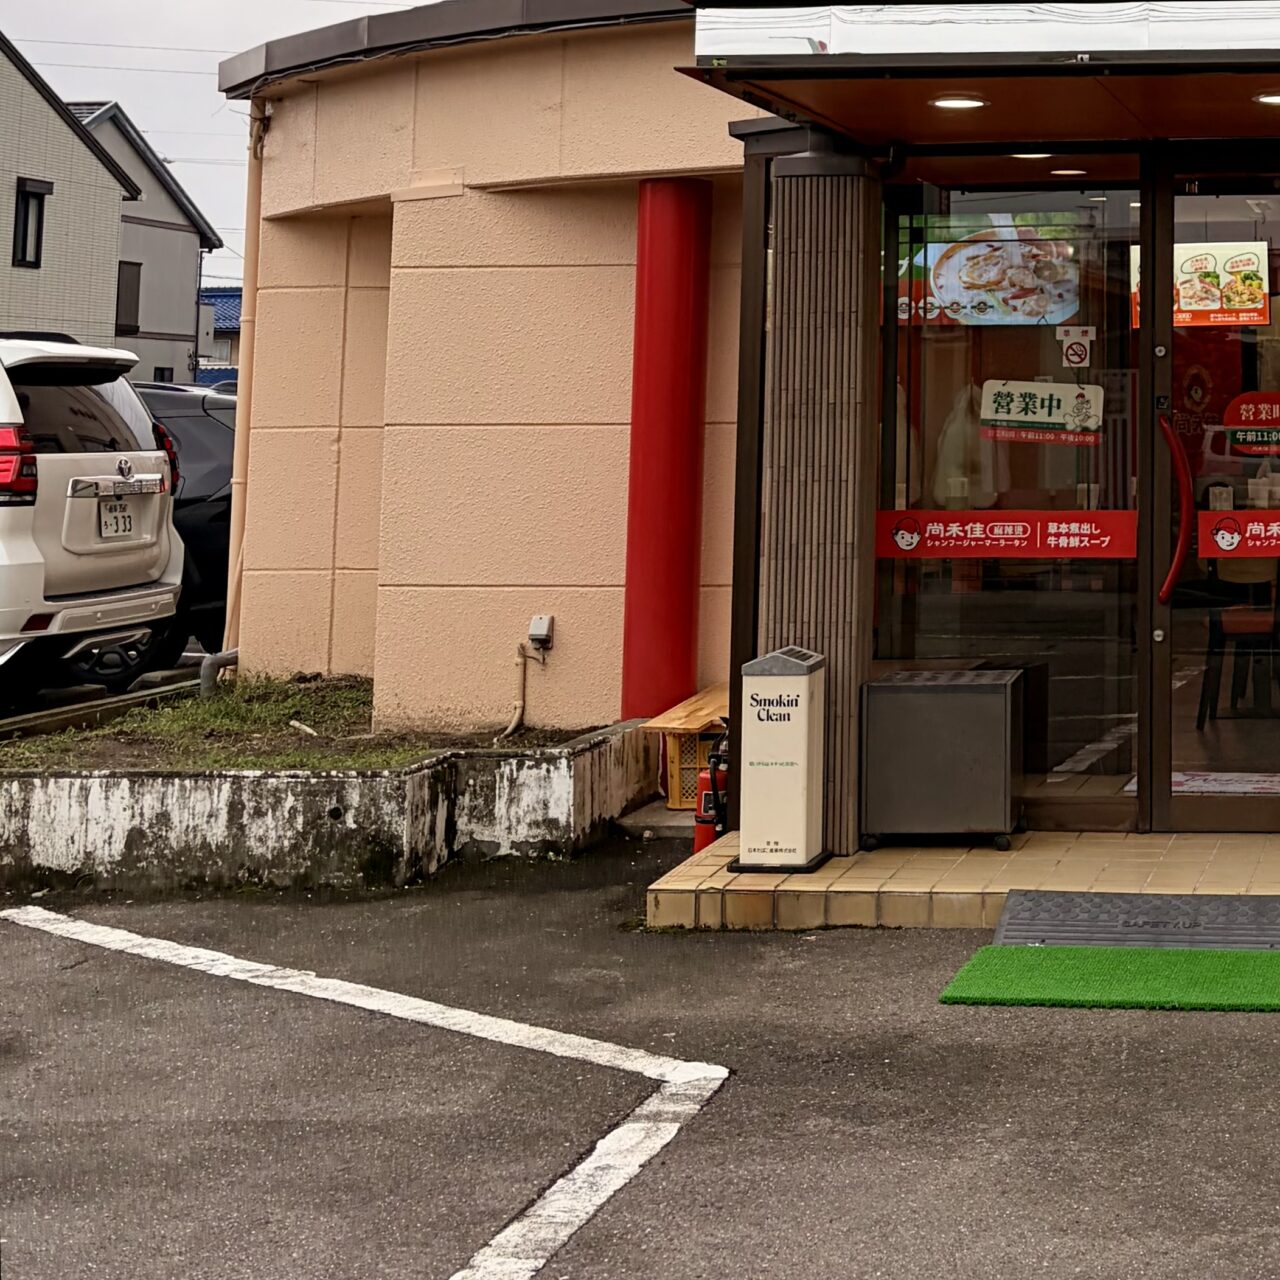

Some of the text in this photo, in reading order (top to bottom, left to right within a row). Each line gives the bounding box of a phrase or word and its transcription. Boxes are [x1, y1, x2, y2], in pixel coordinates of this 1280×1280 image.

[925, 522, 986, 538] 尚禾佳
[756, 708, 791, 722] Clean
